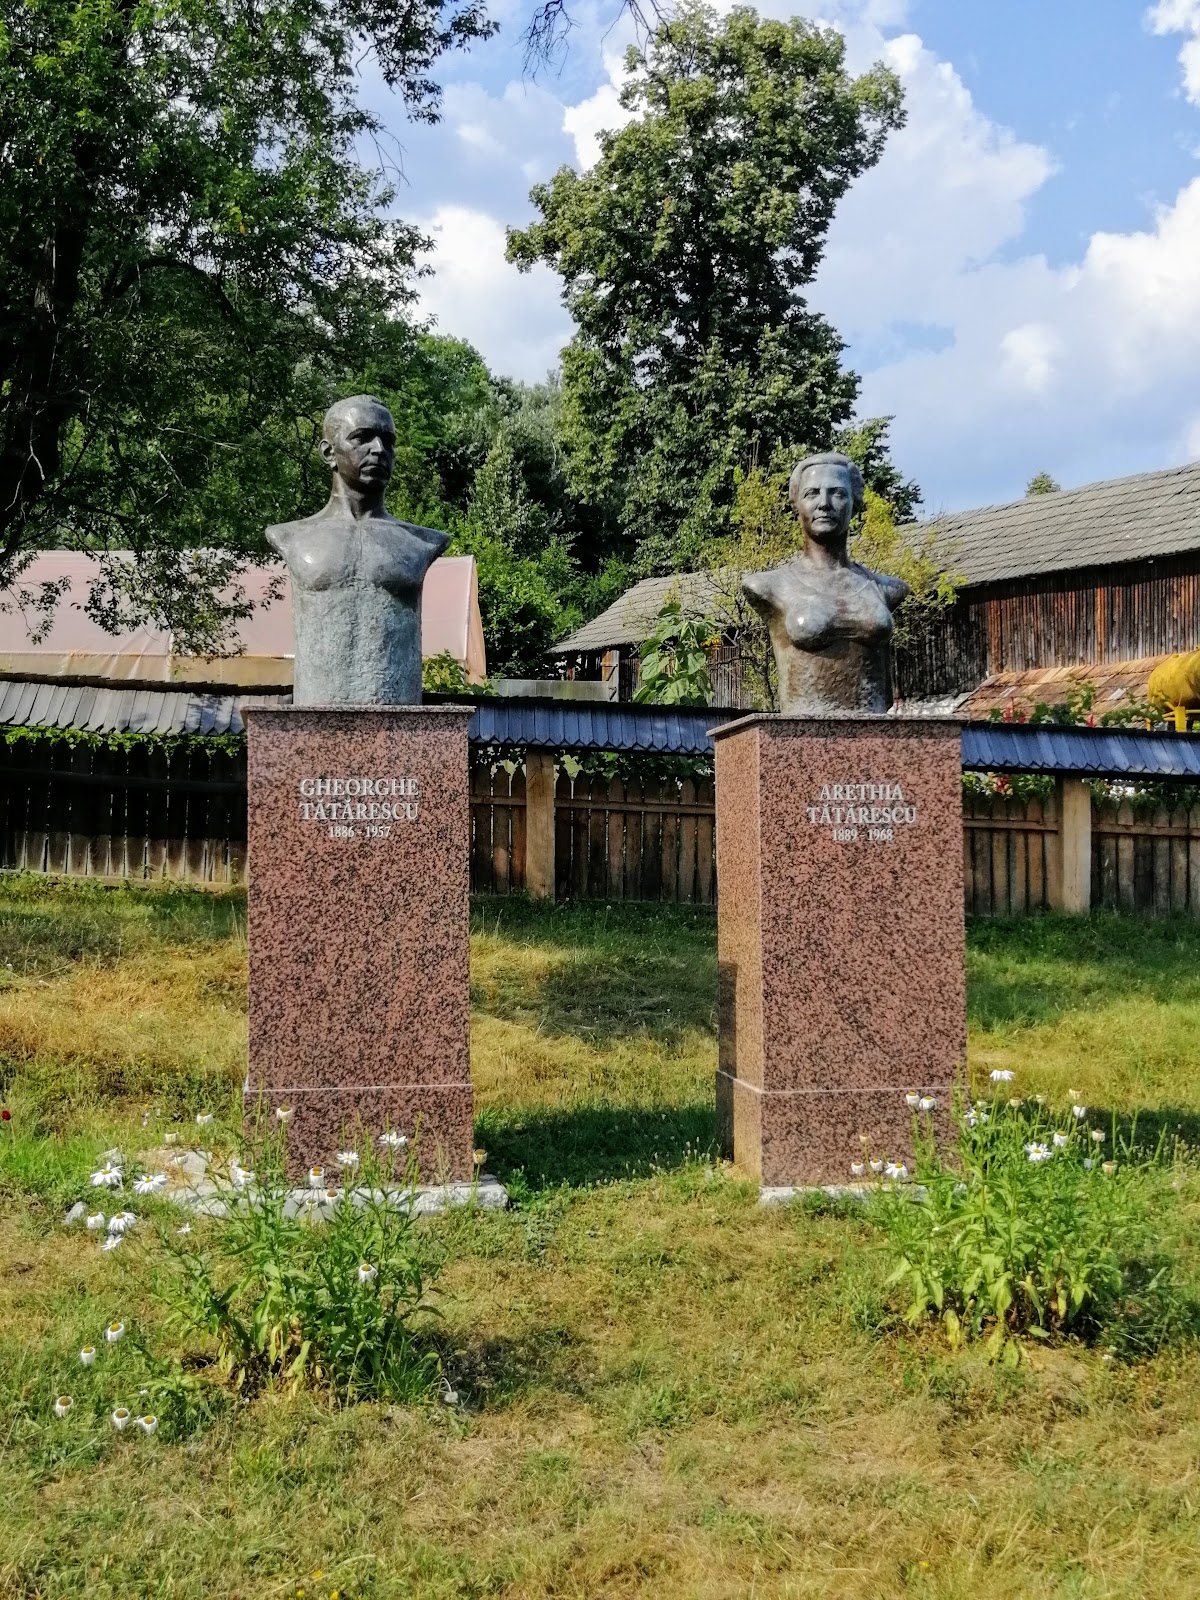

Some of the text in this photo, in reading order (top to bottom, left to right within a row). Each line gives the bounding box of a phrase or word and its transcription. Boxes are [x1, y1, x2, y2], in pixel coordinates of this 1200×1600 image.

[300, 778, 419, 796] GHEORGHE
[819, 784, 904, 801] ARETHIA
[298, 797, 420, 820] TĂTĂRESCU
[806, 802, 917, 824] TĂTĂRESCU
[328, 826, 355, 838] 1886
[365, 825, 391, 838] 1957
[831, 828, 858, 841] 1889
[867, 828, 893, 841] 1968
